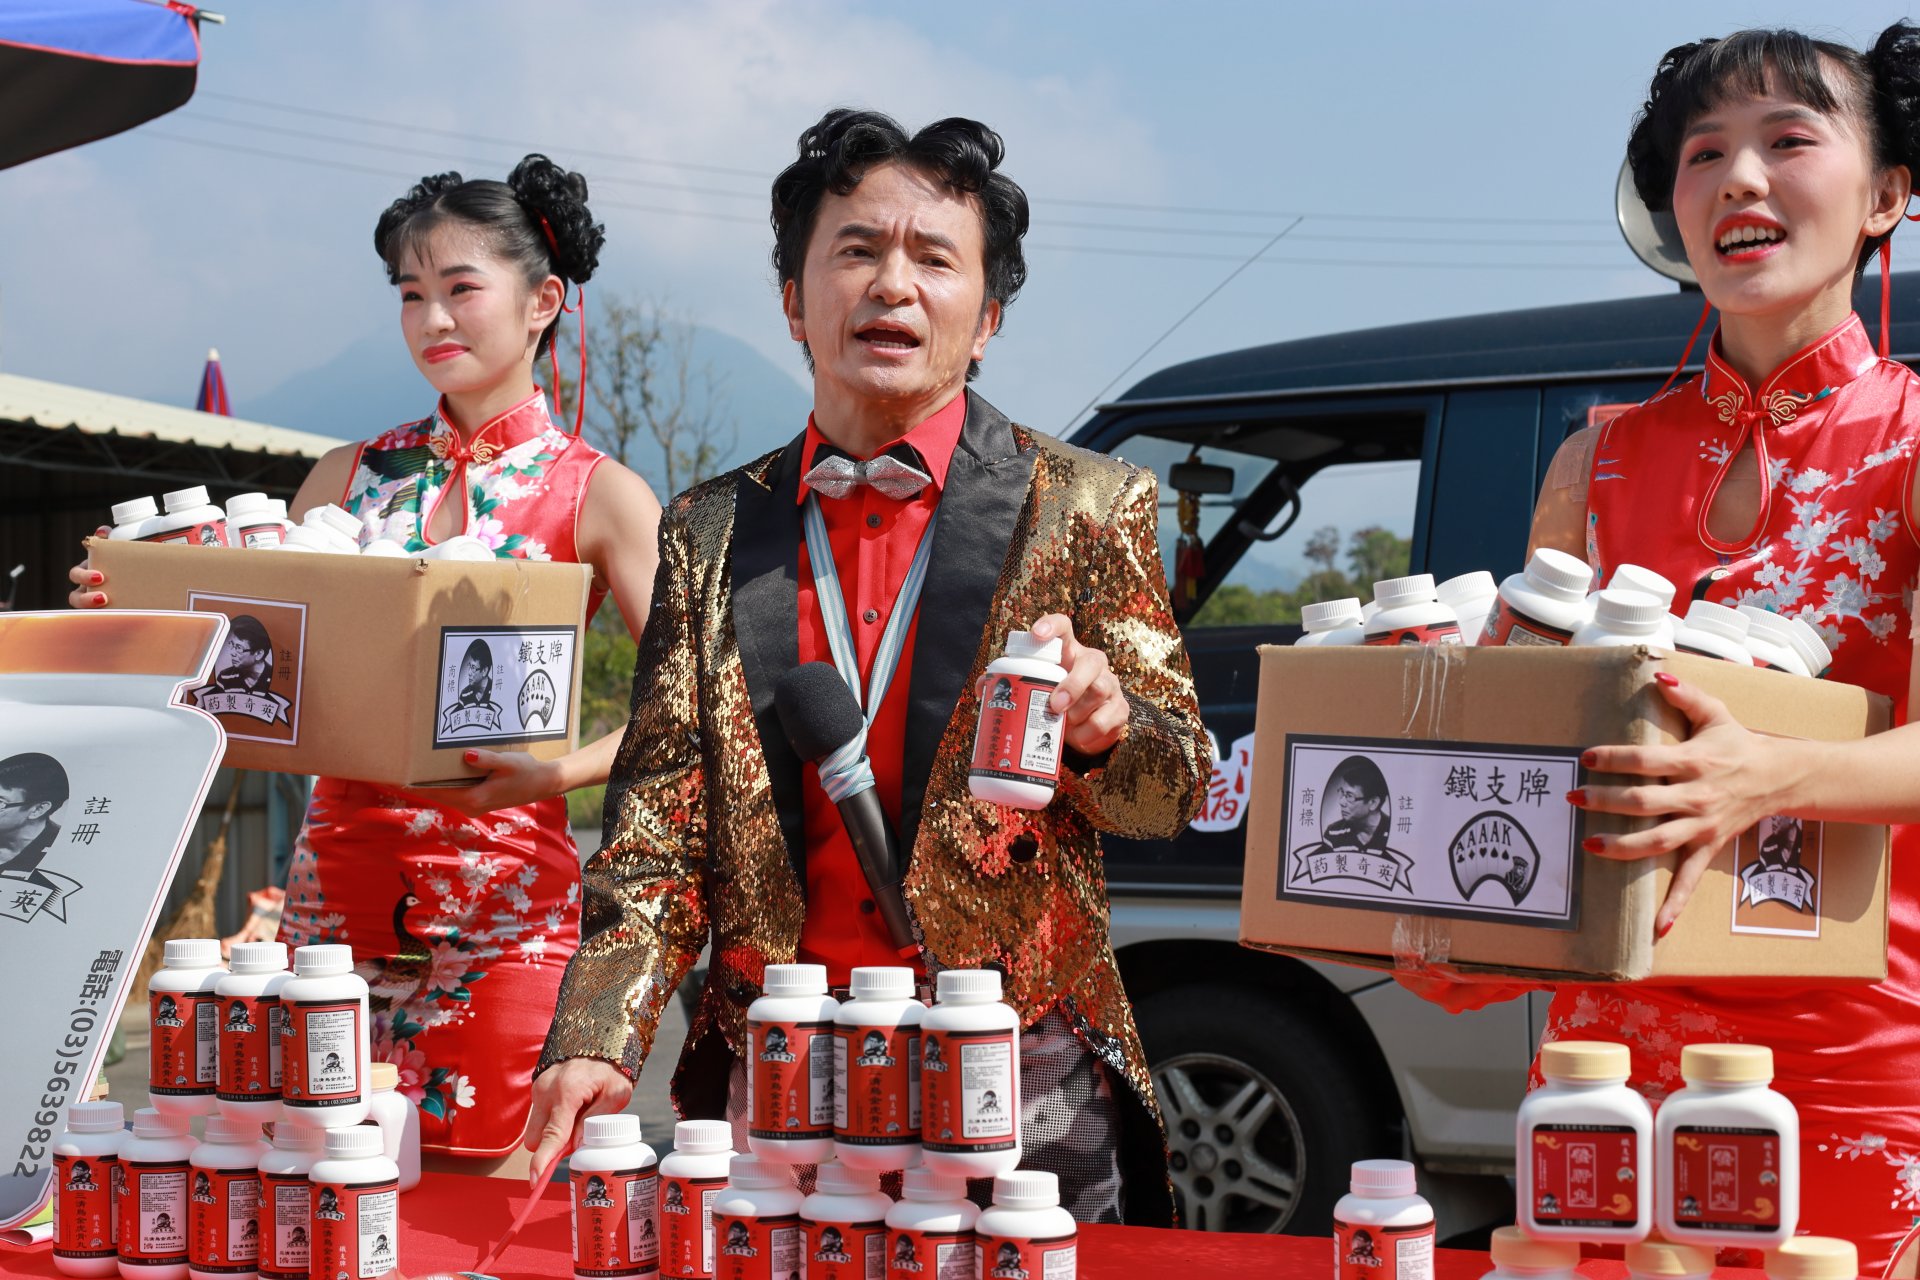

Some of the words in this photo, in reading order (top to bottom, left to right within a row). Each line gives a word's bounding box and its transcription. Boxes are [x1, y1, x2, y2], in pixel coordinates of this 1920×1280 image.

[278, 649, 294, 681] 註冊
[518, 639, 563, 665] 鐵支牌
[447, 664, 456, 694] 商標
[494, 664, 505, 691] 註冊
[1443, 765, 1551, 806] 鐵支牌
[71, 796, 112, 846] 註冊
[1299, 787, 1315, 828] 商標
[1396, 795, 1414, 834] 註冊
[9, 889, 43, 913] 英
